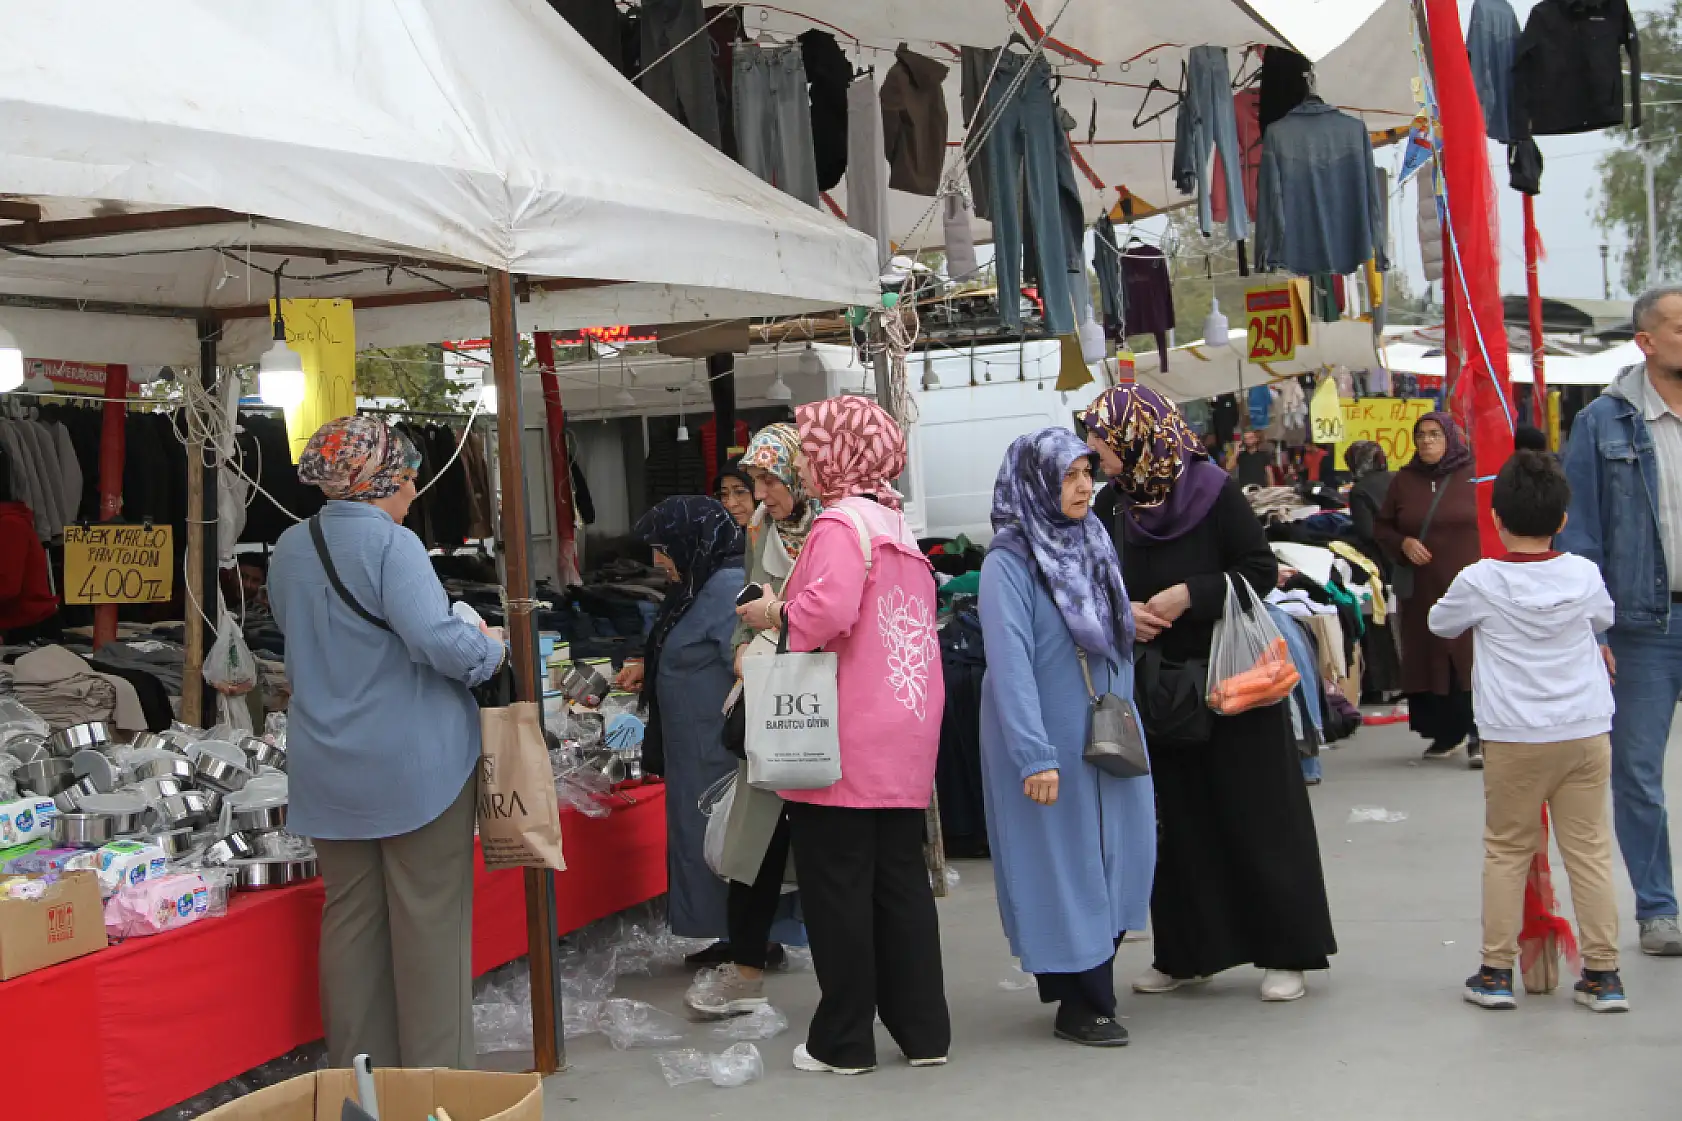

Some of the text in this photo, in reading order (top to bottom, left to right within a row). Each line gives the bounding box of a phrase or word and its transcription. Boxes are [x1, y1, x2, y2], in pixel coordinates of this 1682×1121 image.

[1249, 315, 1293, 358] 250
[65, 528, 110, 545] ERKEK
[773, 692, 822, 717] BG
